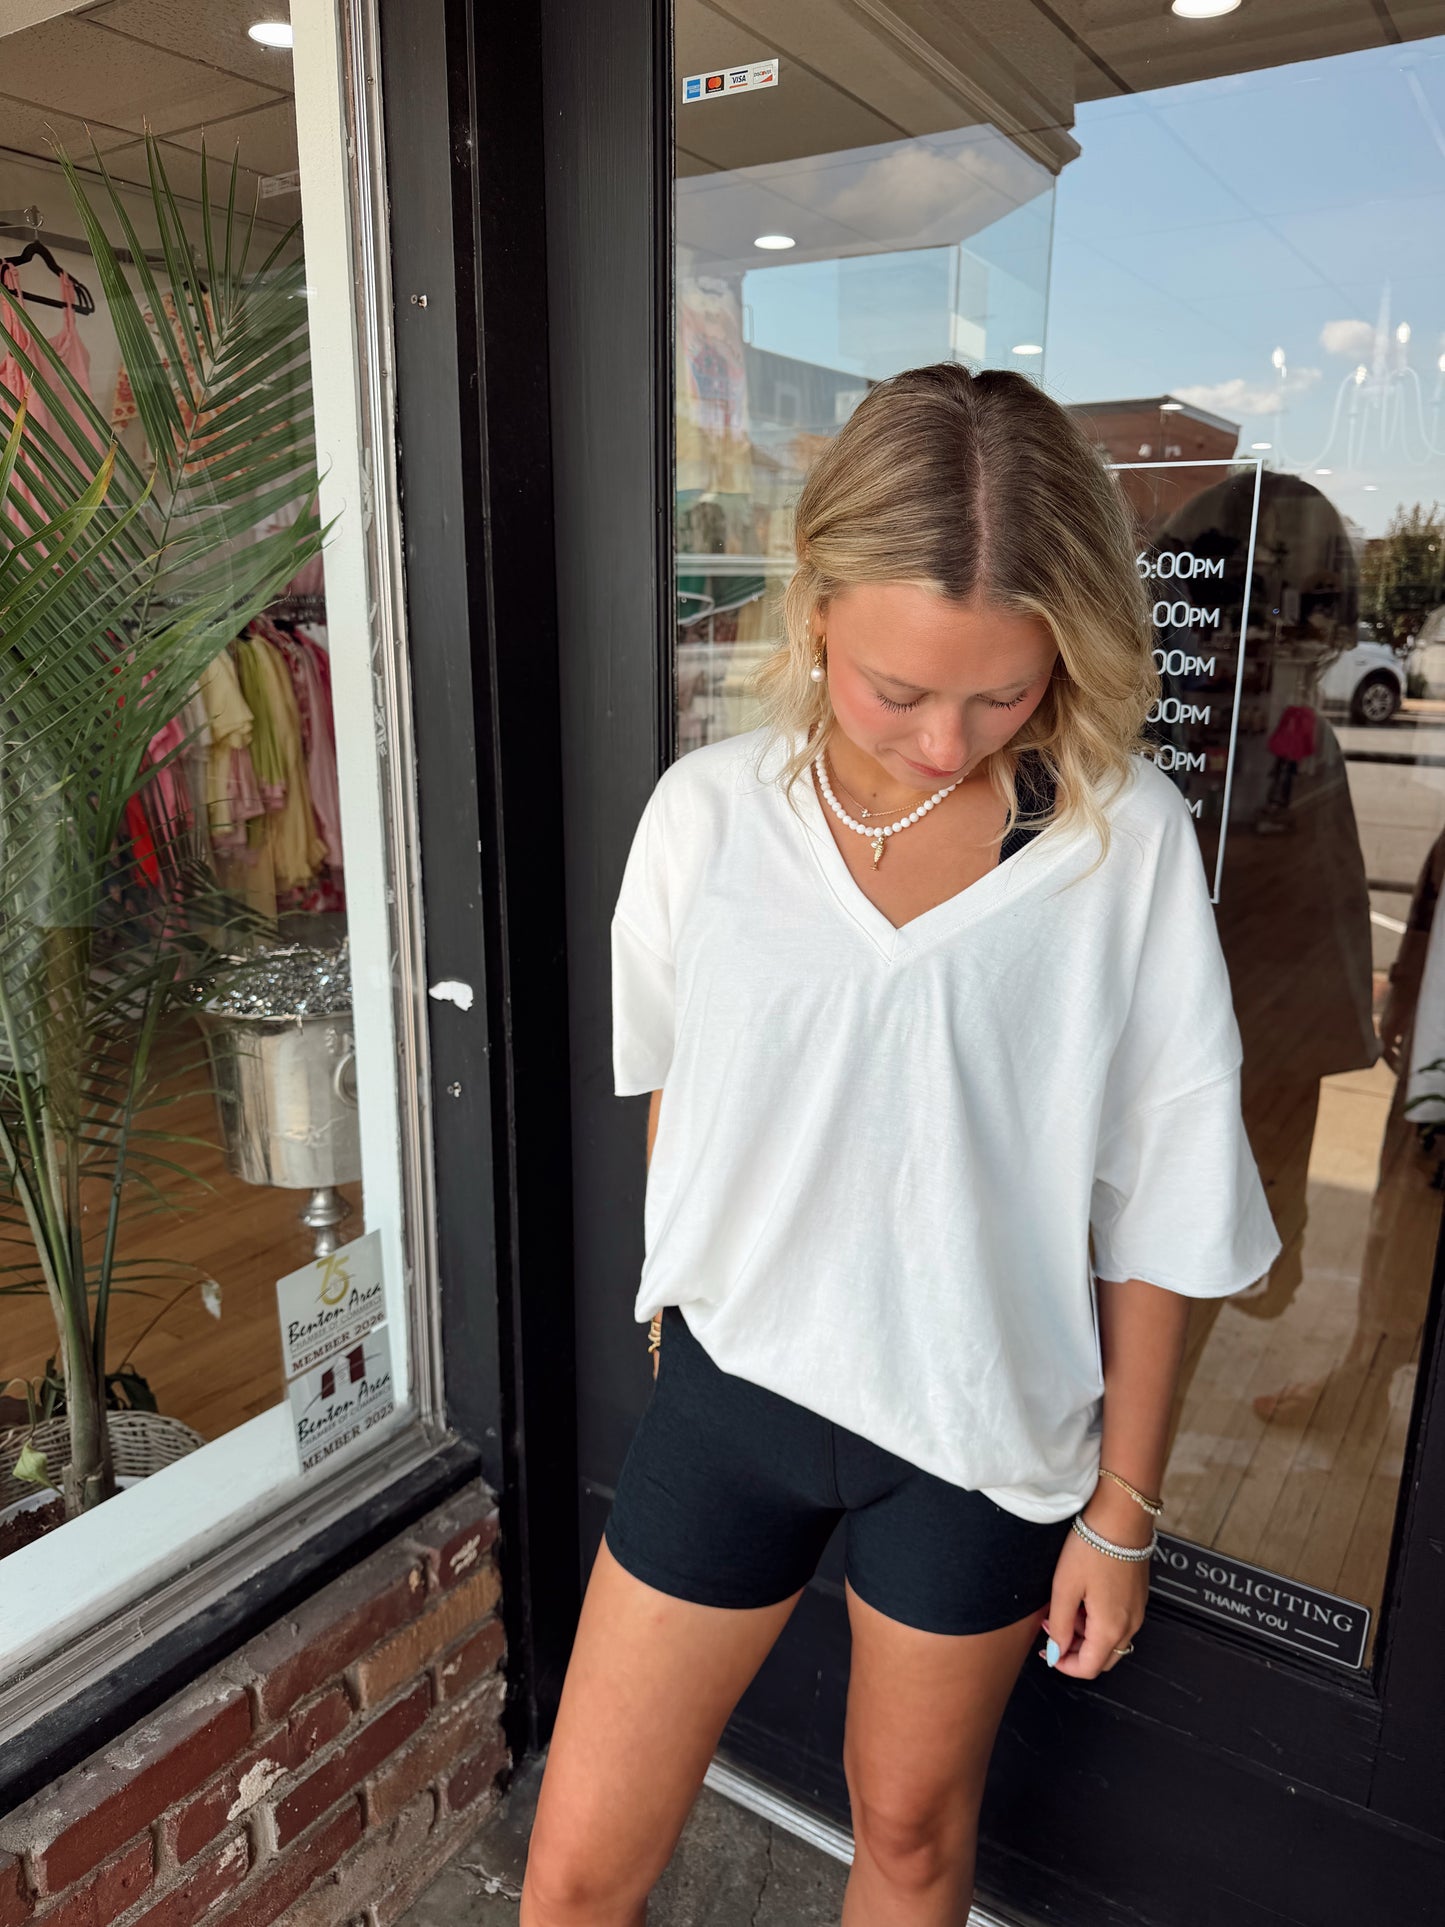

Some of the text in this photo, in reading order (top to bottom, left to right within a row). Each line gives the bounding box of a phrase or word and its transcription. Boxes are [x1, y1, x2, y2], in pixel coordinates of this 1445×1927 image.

[732, 74, 747, 84] VISA
[1135, 551, 1225, 579] 6:00PM
[1151, 601, 1220, 628] 00PM
[1150, 649, 1216, 677] 00PM
[1145, 697, 1211, 725] 00PM
[287, 1283, 382, 1346] Benton Area
[291, 1331, 351, 1372] MEMBER
[297, 1371, 391, 1443] Benton Area
[302, 1401, 395, 1473] MEMBER 2023
[1152, 1544, 1354, 1633] NO SOLICITING
[1203, 1588, 1289, 1632] THANK YOU
